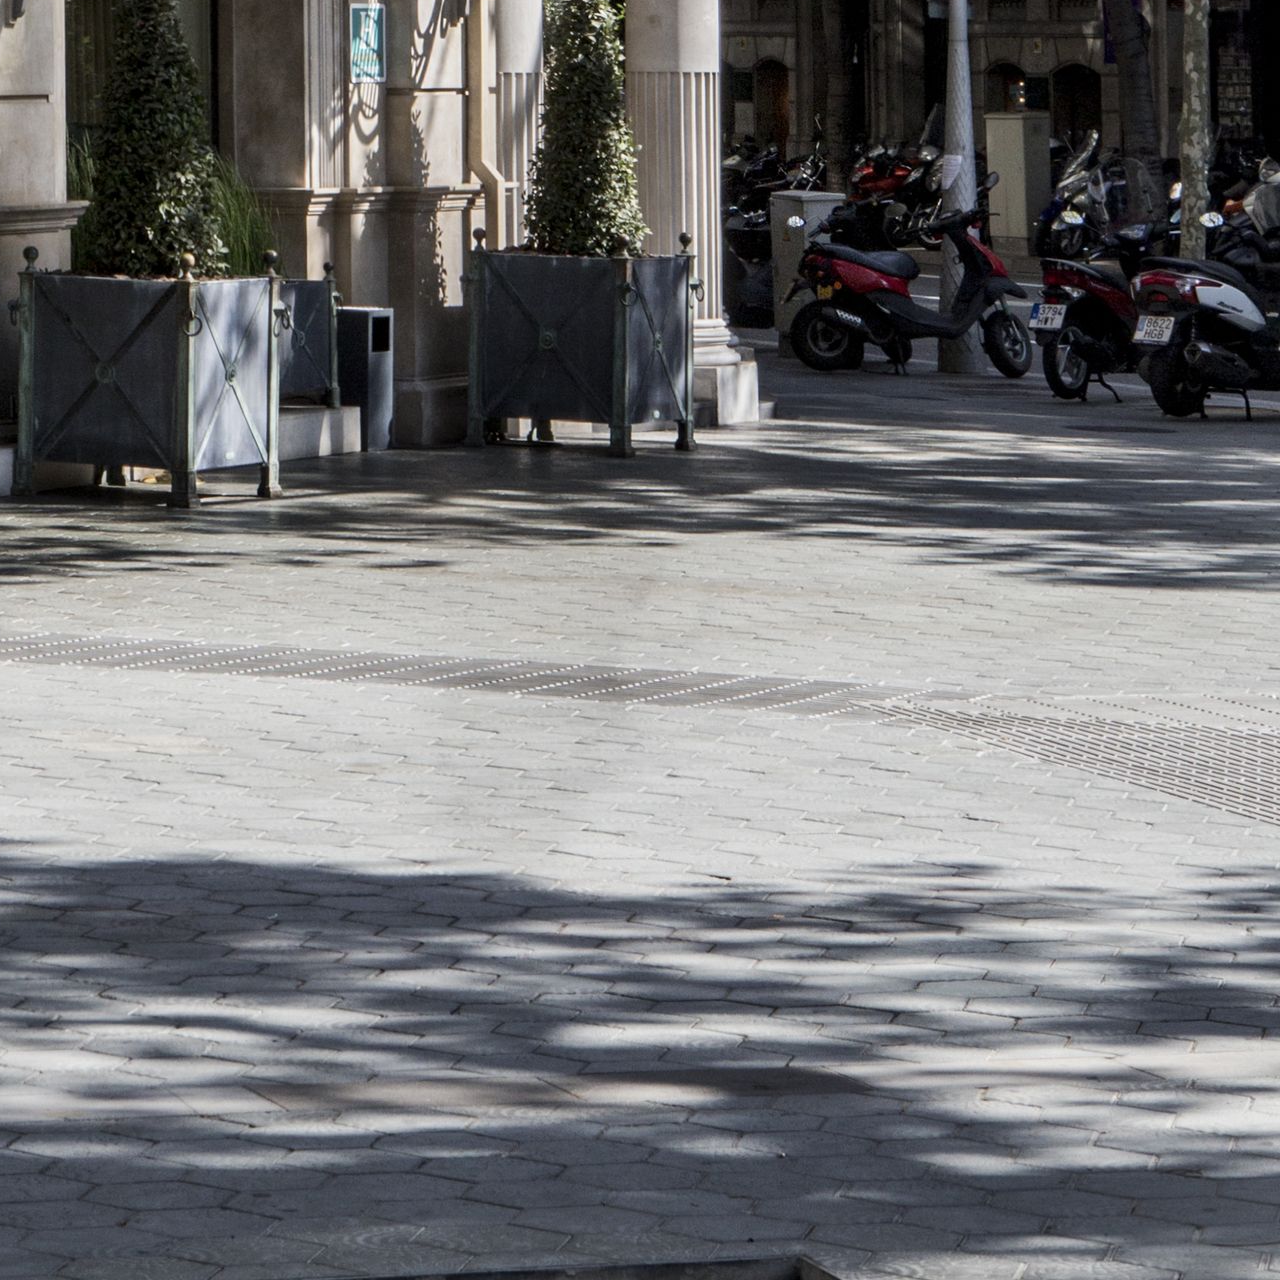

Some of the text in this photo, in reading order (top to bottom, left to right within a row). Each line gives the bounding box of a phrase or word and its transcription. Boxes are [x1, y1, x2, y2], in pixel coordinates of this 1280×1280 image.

[359, 11, 378, 49] H
[1039, 306, 1063, 316] 3794
[1145, 317, 1172, 329] 8622
[1143, 328, 1164, 340] HGB
